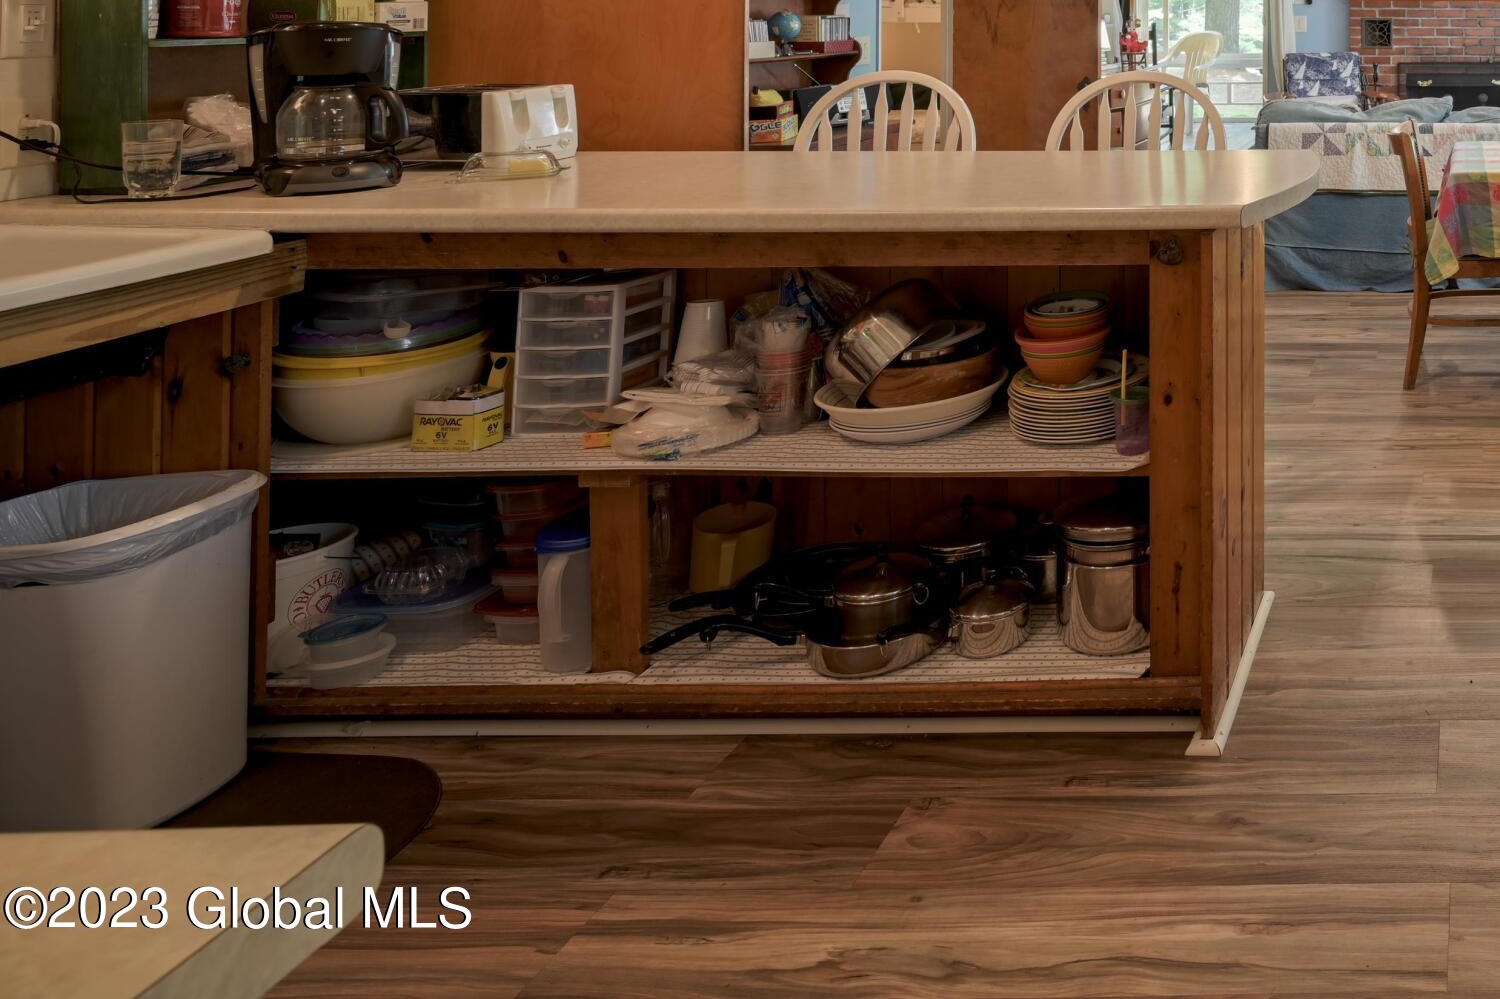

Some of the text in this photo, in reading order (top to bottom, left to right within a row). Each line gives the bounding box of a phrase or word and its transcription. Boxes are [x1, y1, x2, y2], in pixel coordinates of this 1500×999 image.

[420, 416, 463, 426] RAYOVAC
[487, 421, 499, 431] 6V
[435, 431, 447, 439] 6V
